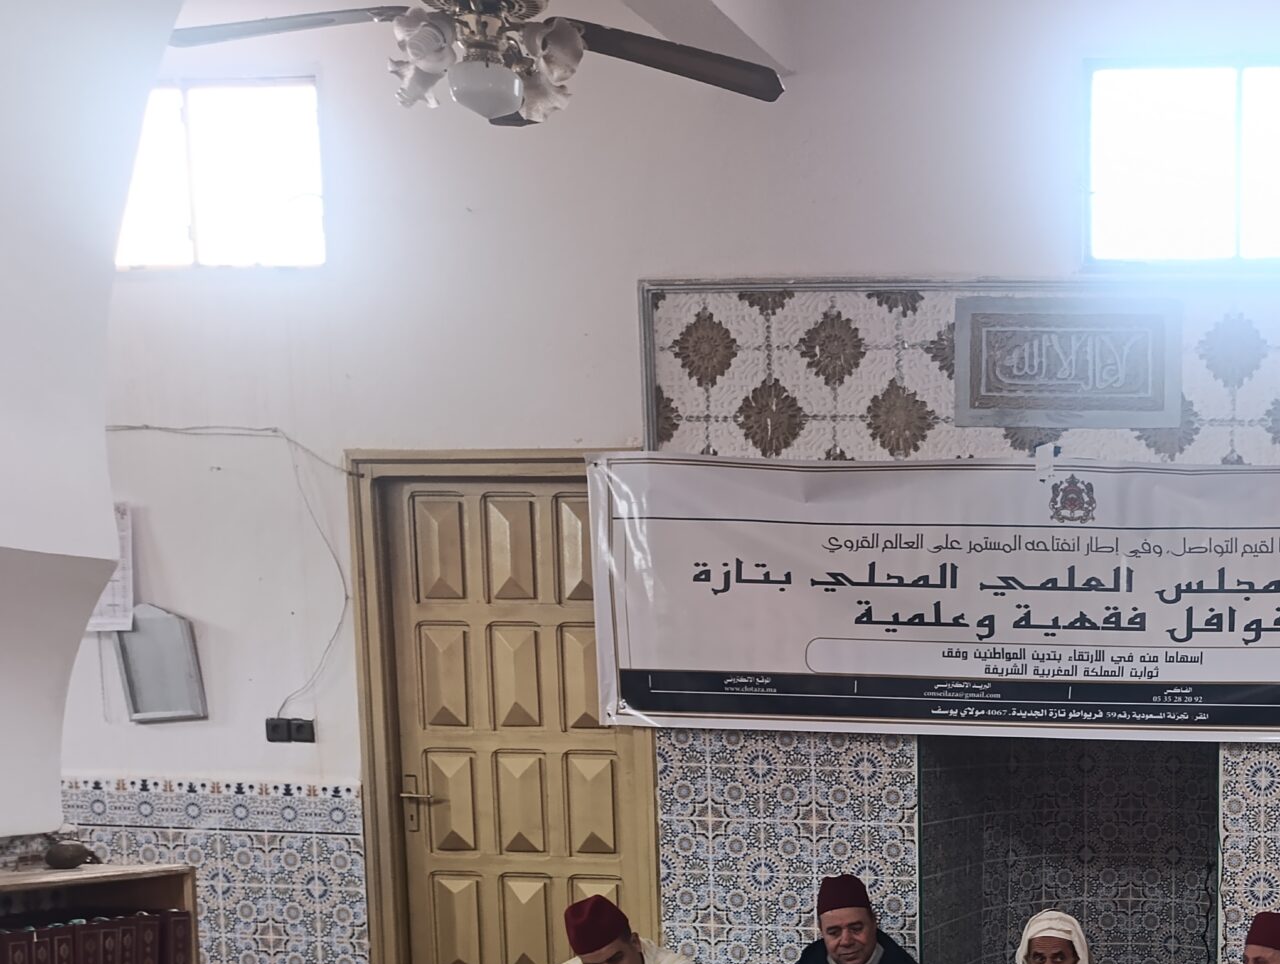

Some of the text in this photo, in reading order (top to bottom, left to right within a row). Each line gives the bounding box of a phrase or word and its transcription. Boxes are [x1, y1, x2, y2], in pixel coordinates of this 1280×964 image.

[821, 533, 879, 554] القروي
[882, 533, 924, 553] العالم
[927, 533, 963, 554] على
[966, 534, 1022, 554] المستمر
[1024, 535, 1081, 555] انفتاحه
[1083, 535, 1120, 556] إطار
[1122, 539, 1163, 559] وفي
[1241, 536, 1275, 558] لقيم
[692, 557, 792, 596] بتازة
[810, 560, 958, 593] المحلي
[980, 564, 1135, 597] العلمي
[854, 600, 996, 642] وعلمية
[1012, 603, 1147, 638] فقهية
[941, 647, 968, 661] وفق
[973, 647, 1027, 662] المواطنين
[1031, 649, 1063, 664] بتدين
[1110, 651, 1134, 664] في
[1139, 652, 1159, 664] منه
[1165, 649, 1204, 666] إسهاما
[984, 663, 1159, 679] ثوابت المملكة المغربية الشريفة
[930, 705, 959, 717] يوسف
[1048, 708, 1067, 719] تازة
